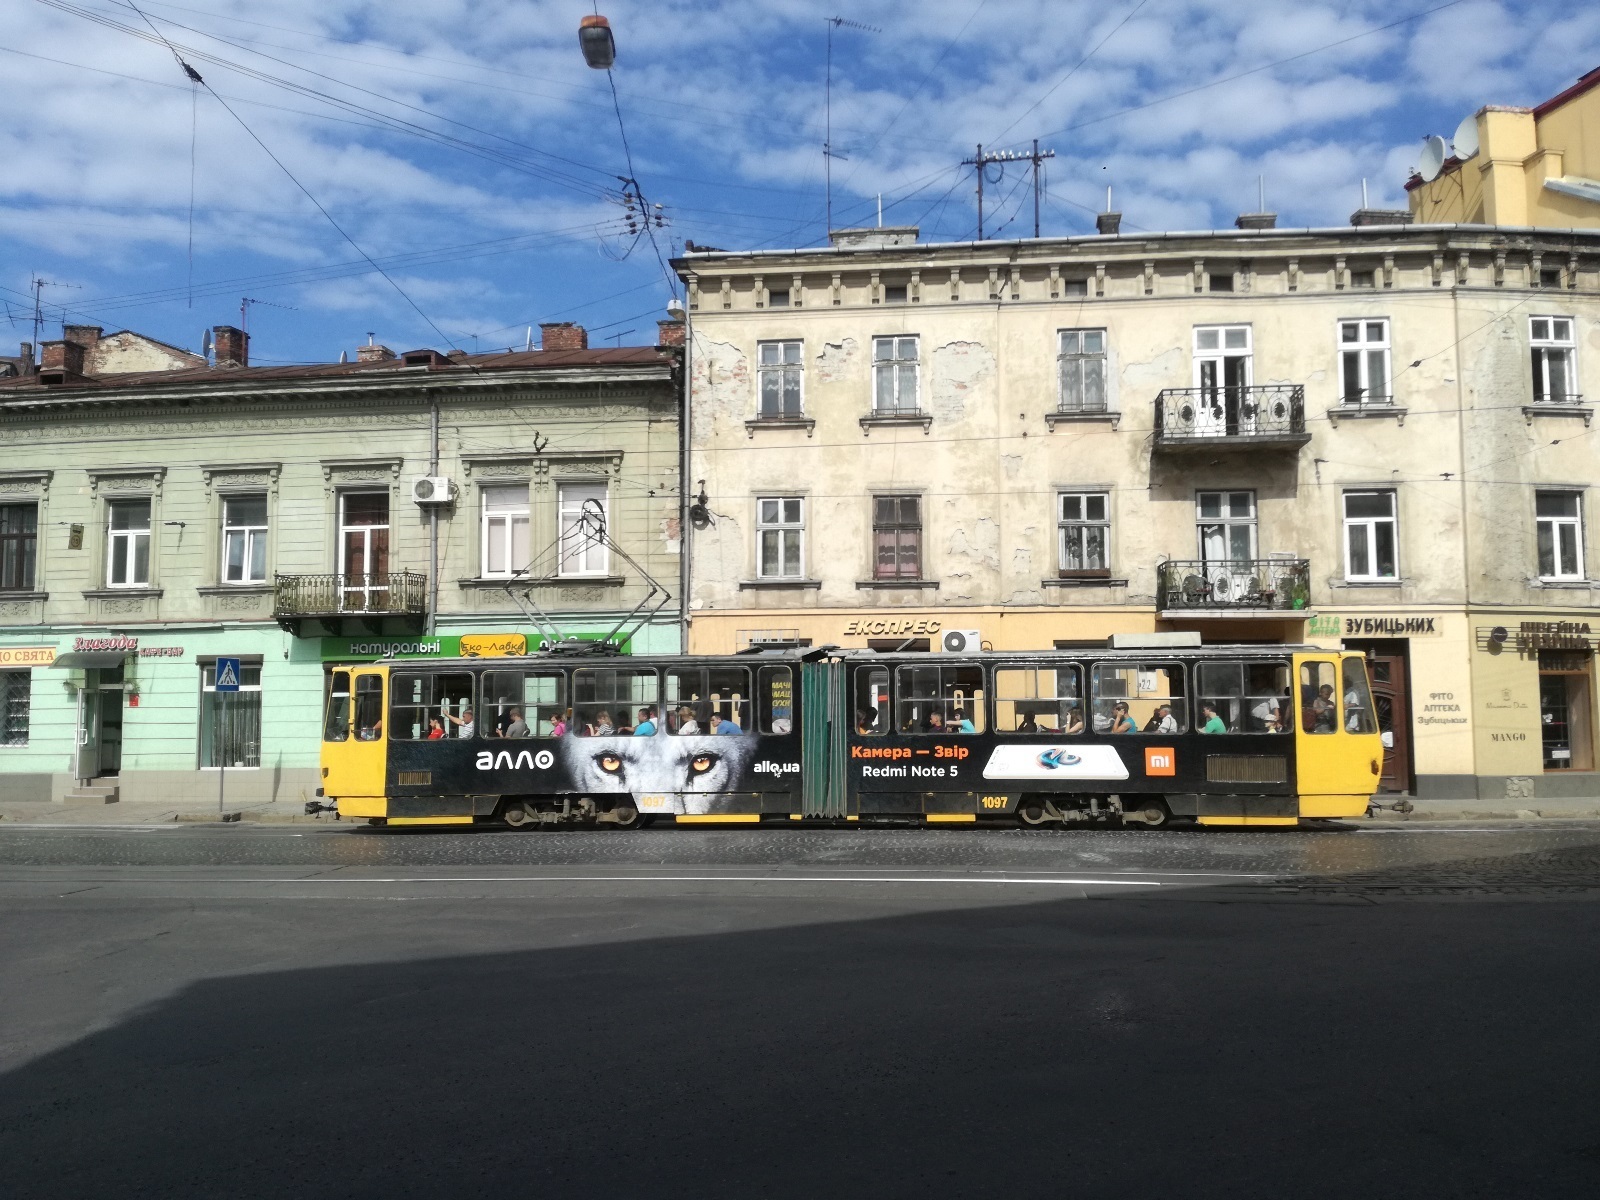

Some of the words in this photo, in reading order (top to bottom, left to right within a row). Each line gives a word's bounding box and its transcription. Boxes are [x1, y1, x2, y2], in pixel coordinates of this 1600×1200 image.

[843, 619, 941, 635] ЕКСПРЕС
[1345, 617, 1435, 636] ЗУБИЦЬКИХ
[1520, 620, 1592, 634] ШВЕЙНА
[73, 634, 138, 651] Злагода
[14, 650, 55, 661] СВЯТА
[1429, 692, 1454, 701] ФІТО
[1423, 704, 1461, 712] АПТЕКА
[1491, 732, 1526, 742] MANGO
[851, 745, 912, 760] Камера
[934, 745, 969, 760] Звір
[753, 760, 800, 773] allo.ua
[862, 765, 907, 777] Redmi
[911, 765, 945, 777] Note
[949, 765, 958, 777] 5
[642, 796, 665, 807] 1097
[981, 796, 1008, 808] 1097
